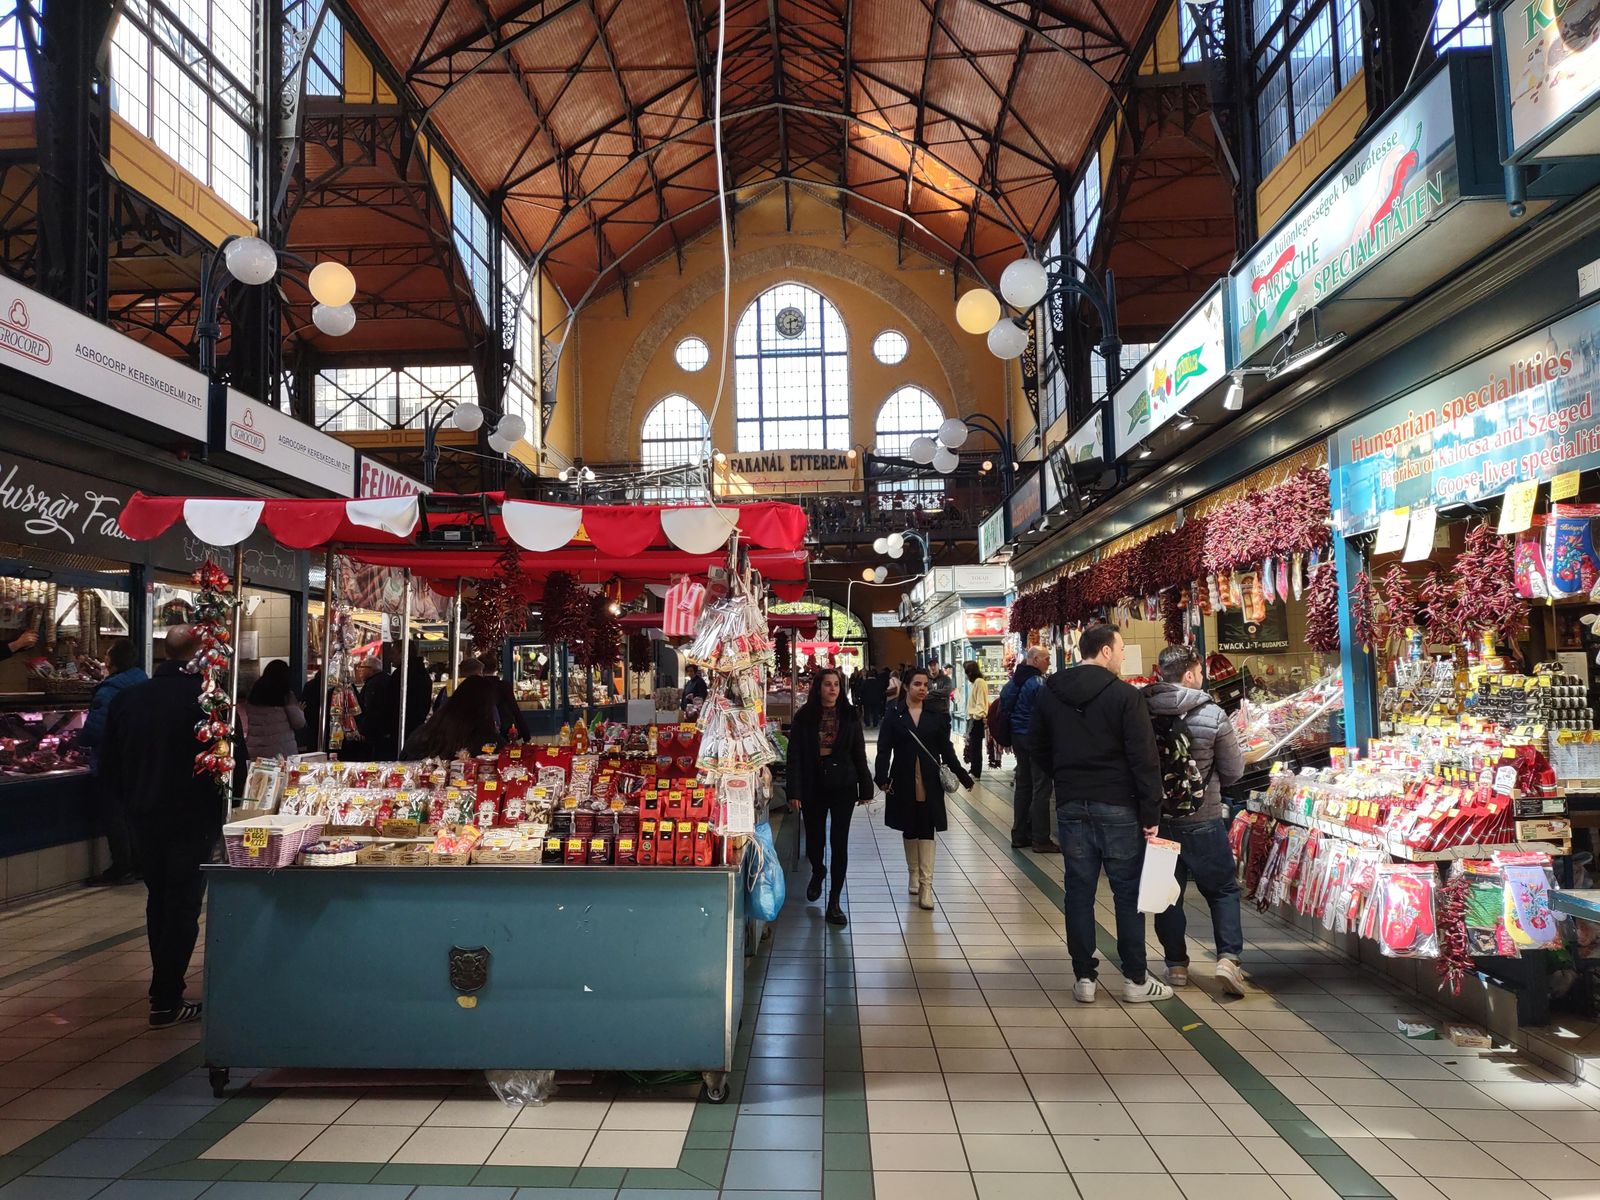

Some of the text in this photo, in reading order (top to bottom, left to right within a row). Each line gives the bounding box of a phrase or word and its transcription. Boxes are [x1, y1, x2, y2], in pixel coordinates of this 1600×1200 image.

[1341, 130, 1399, 194] Delicatesse
[1312, 170, 1444, 301] SPECIALITÄTEN
[1240, 237, 1320, 325] UNGARISCHE
[75, 343, 202, 408] AGROCORP KERESKEDELMI ZRT.
[1351, 350, 1573, 463] Hungarian specialities
[233, 427, 262, 449] AGROCORP
[278, 434, 307, 453] AGROCORP
[730, 453, 785, 475] FAKANÁL
[1381, 460, 1421, 490] Paprika
[1438, 437, 1490, 467] Kalocsa
[1493, 424, 1524, 449] and
[1527, 391, 1593, 435] Szeged
[1436, 456, 1517, 499] Goose-liver
[1218, 641, 1245, 651] ZWACK
[1262, 640, 1288, 649] BUDAPEST
